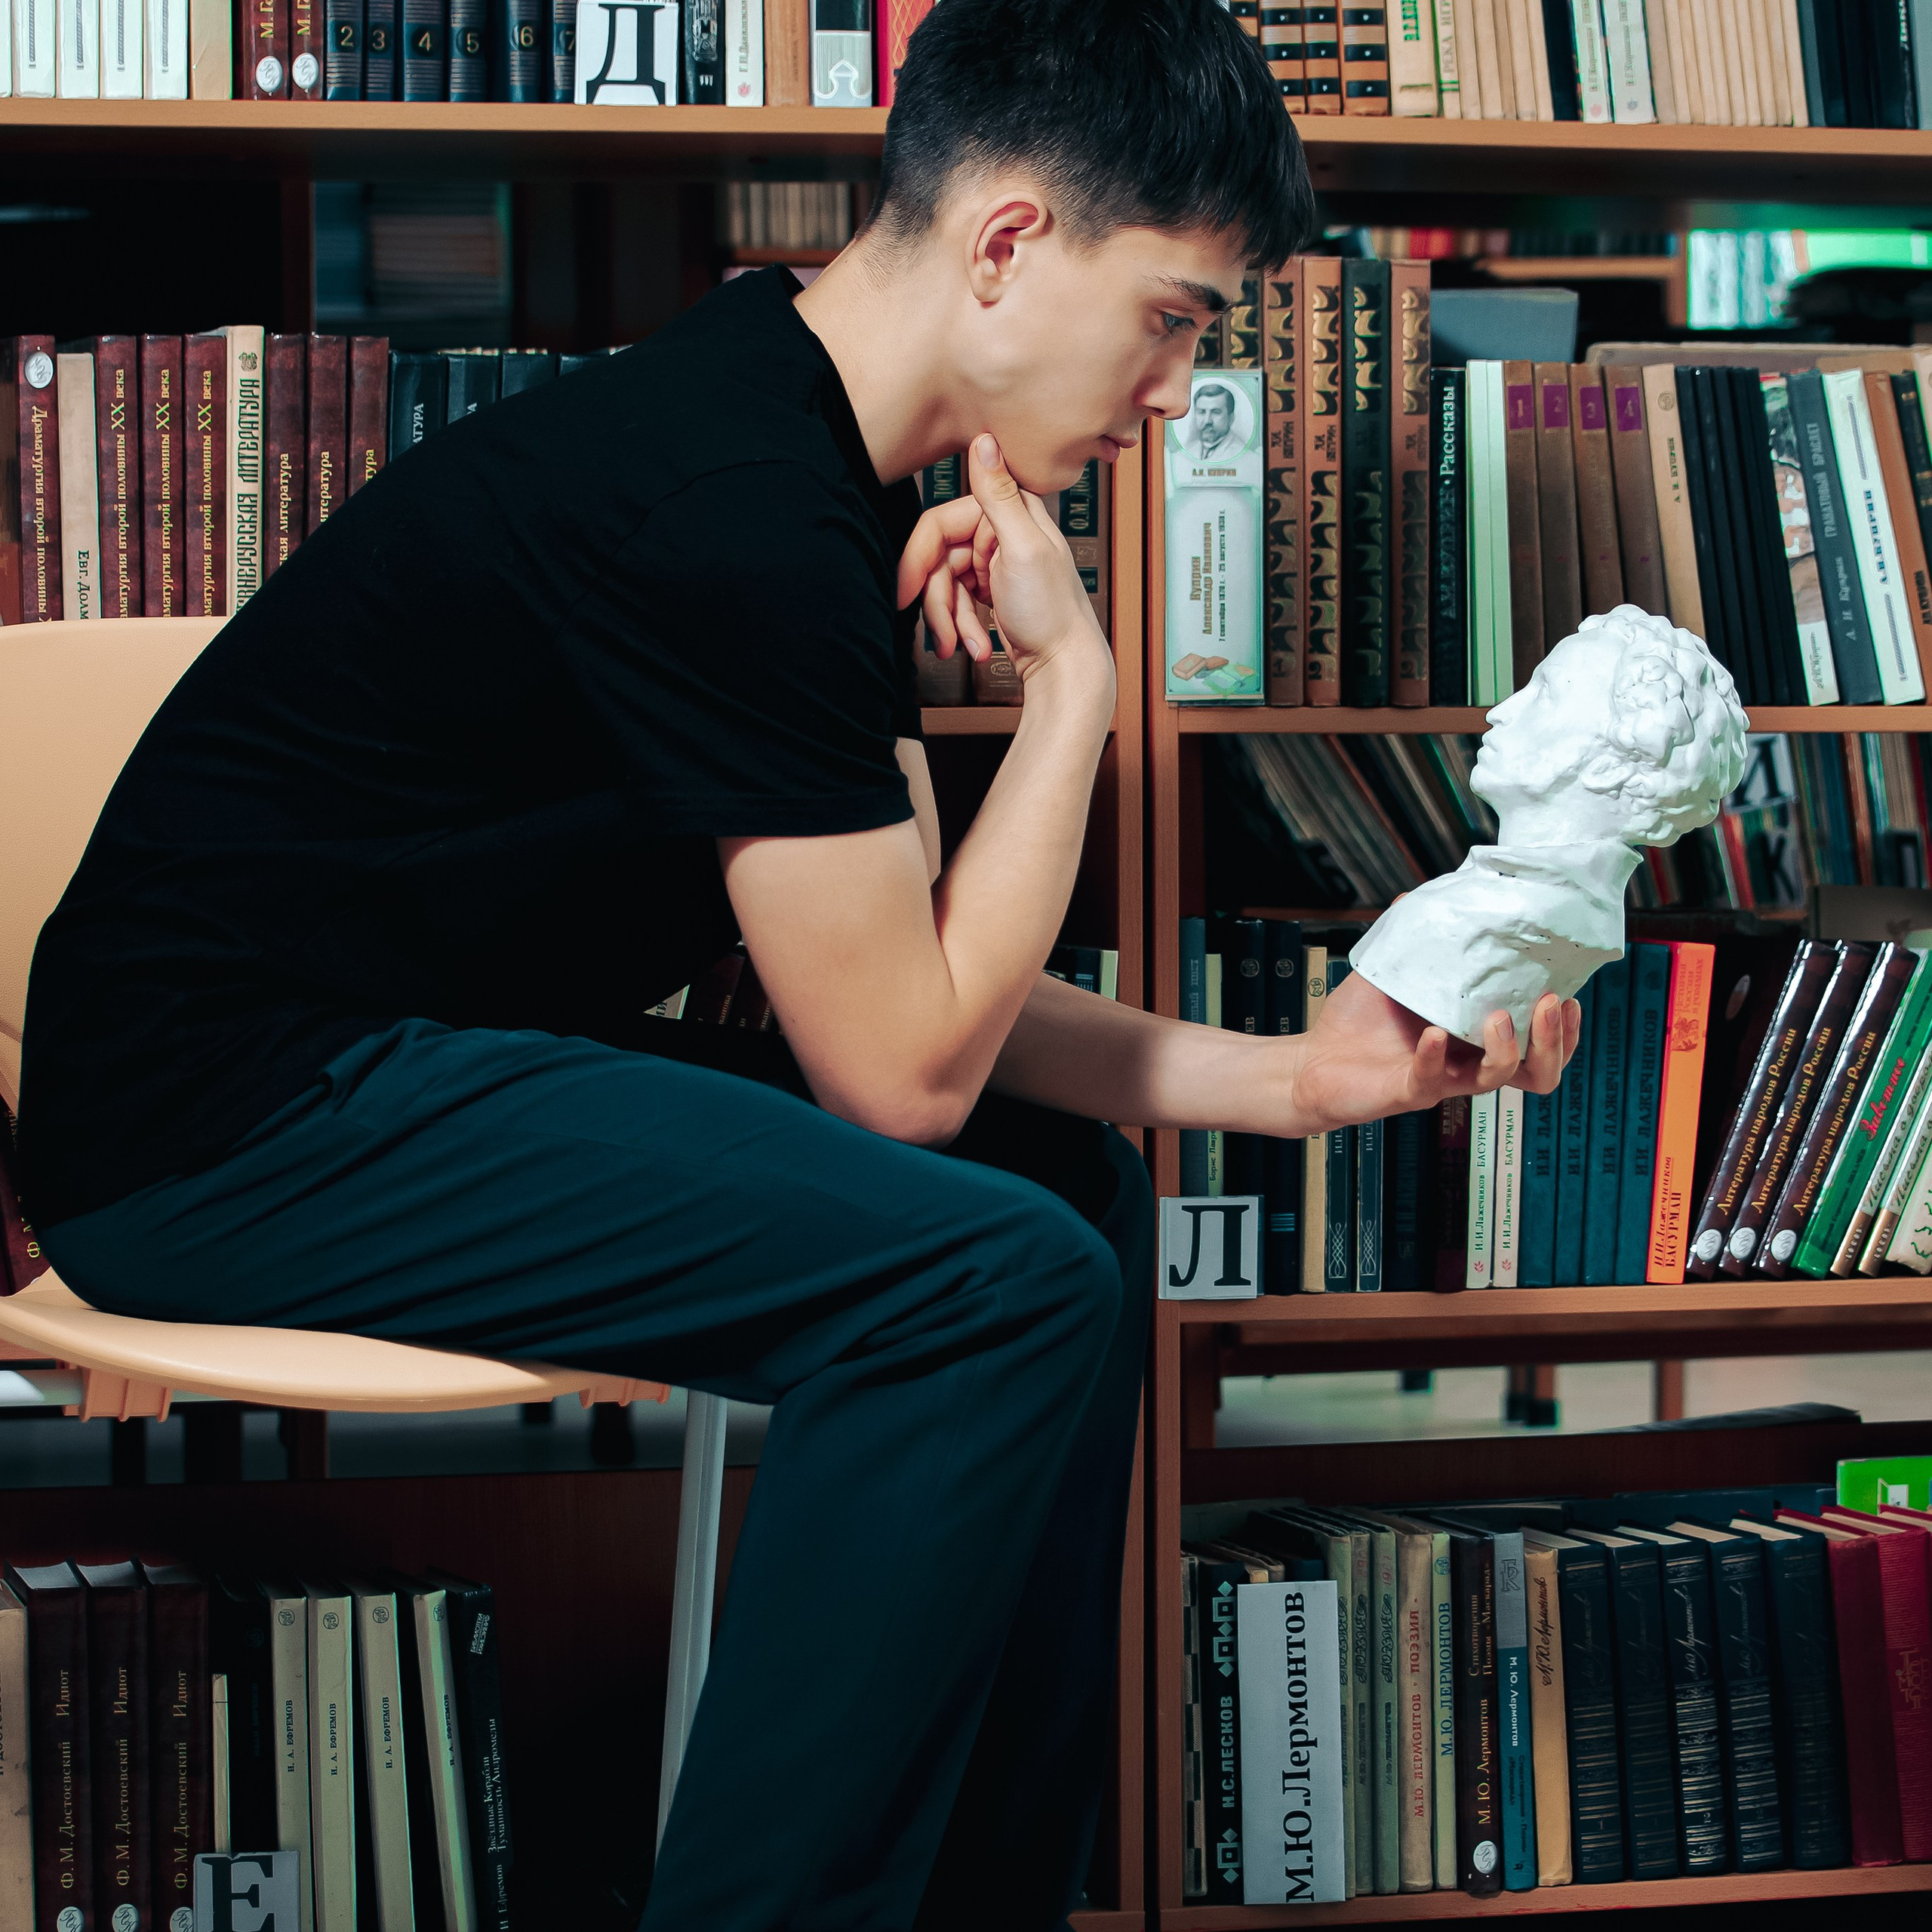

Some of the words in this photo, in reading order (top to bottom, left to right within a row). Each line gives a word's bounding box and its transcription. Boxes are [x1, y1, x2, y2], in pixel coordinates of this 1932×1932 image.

[260, 17, 274, 38] М.
[297, 14, 311, 35] М.
[340, 25, 354, 46] 2
[371, 29, 386, 49] 3
[417, 32, 433, 52] 4
[466, 32, 480, 52] 5
[520, 26, 534, 48] 6
[565, 30, 576, 51] 7
[586, 3, 666, 105] Д
[114, 368, 125, 399] века
[160, 368, 171, 399] века
[201, 370, 212, 400] века
[1554, 395, 1562, 413] 2
[237, 378, 260, 482] ЛИТЕРАТУРА
[1438, 385, 1456, 477] Рассказы
[1517, 398, 1524, 419] 1
[1586, 401, 1596, 420] 3
[32, 405, 48, 494] Драматургия
[115, 433, 127, 500] половины
[159, 433, 171, 500] половины
[202, 434, 214, 501] половины
[278, 453, 292, 534] литература
[934, 457, 954, 499] ДОСТО
[34, 497, 50, 544] второй
[114, 503, 129, 549] второй
[158, 503, 173, 549] второй
[198, 503, 214, 550] второй
[35, 547, 47, 614] половины
[77, 549, 89, 578] Евг.
[1189, 556, 1202, 601] Куприн
[77, 580, 91, 620] Долм
[1201, 576, 1214, 635] Александр
[1308, 660, 1322, 681] 2
[1602, 1007, 1620, 1136] ЛАЖЕЧНИКОВ
[1637, 1008, 1659, 1139] ЛАЖЕЧНИКОВ
[1476, 1111, 1487, 1168] БАСУРМАН
[1504, 1109, 1514, 1166] БАСУРМАН
[1718, 1138, 1756, 1216] Литература
[1752, 1081, 1777, 1135] народов
[1770, 1030, 1796, 1077] России
[1752, 1137, 1790, 1214] Литература
[1786, 1080, 1811, 1133] народов
[1804, 1029, 1832, 1076] России
[1795, 1140, 1833, 1216] Литература
[1829, 1084, 1855, 1137] народов
[1848, 1033, 1876, 1080] России
[1208, 1157, 1218, 1181] Борис
[1474, 1174, 1485, 1251] И.И.Лажечников
[1502, 1173, 1512, 1249] И.И.Лажечников
[1168, 1204, 1252, 1287] Л
[1409, 1609, 1420, 1675] ПОЭЗИЯ
[1438, 1601, 1453, 1711] ЛЕРМОНТОВ
[1510, 1656, 1518, 1669] М.
[55, 1669, 70, 1717] Идиот
[114, 1666, 128, 1715] Идиот
[173, 1670, 187, 1718] Идиот
[1510, 1672, 1518, 1686] Ю.
[285, 1700, 294, 1746] ЕФРЕМОВ
[383, 1697, 392, 1743] ЕФРЕМОВ
[443, 1694, 453, 1740] ЕФРЕМОВ
[1439, 1715, 1453, 1736] Ю.
[1476, 1699, 1491, 1774] Лермонтов
[1510, 1689, 1519, 1746] Лермонтов
[287, 1749, 294, 1759] А.
[288, 1763, 295, 1773] И.
[330, 1752, 337, 1762] А.
[384, 1746, 392, 1755] А.
[385, 1759, 393, 1769] И.
[1220, 1695, 1235, 1808] Н.С.ЛЕСКОВ
[1281, 1592, 1318, 1903] М.Ю.Лермонтов
[1440, 1738, 1453, 1756] М.
[58, 1740, 76, 1838] Достоевский
[115, 1738, 131, 1835] Достоевский
[173, 1741, 189, 1838] Достоевский
[331, 1766, 338, 1776] И.
[481, 1755, 494, 1803] Корабли
[1476, 1777, 1491, 1801] Ю.
[494, 1786, 508, 1853] Туманность
[1477, 1804, 1491, 1825] М.
[1703, 1811, 1712, 1824] 2
[60, 1842, 74, 1863] М.
[115, 1839, 130, 1860] М.
[174, 1842, 187, 1863] М.
[60, 1867, 75, 1889] Ф.
[116, 1865, 131, 1886] Ф.
[174, 1867, 188, 1889] Ф.
[201, 1854, 275, 1932] Е
[494, 1864, 510, 1913] Ефремов
